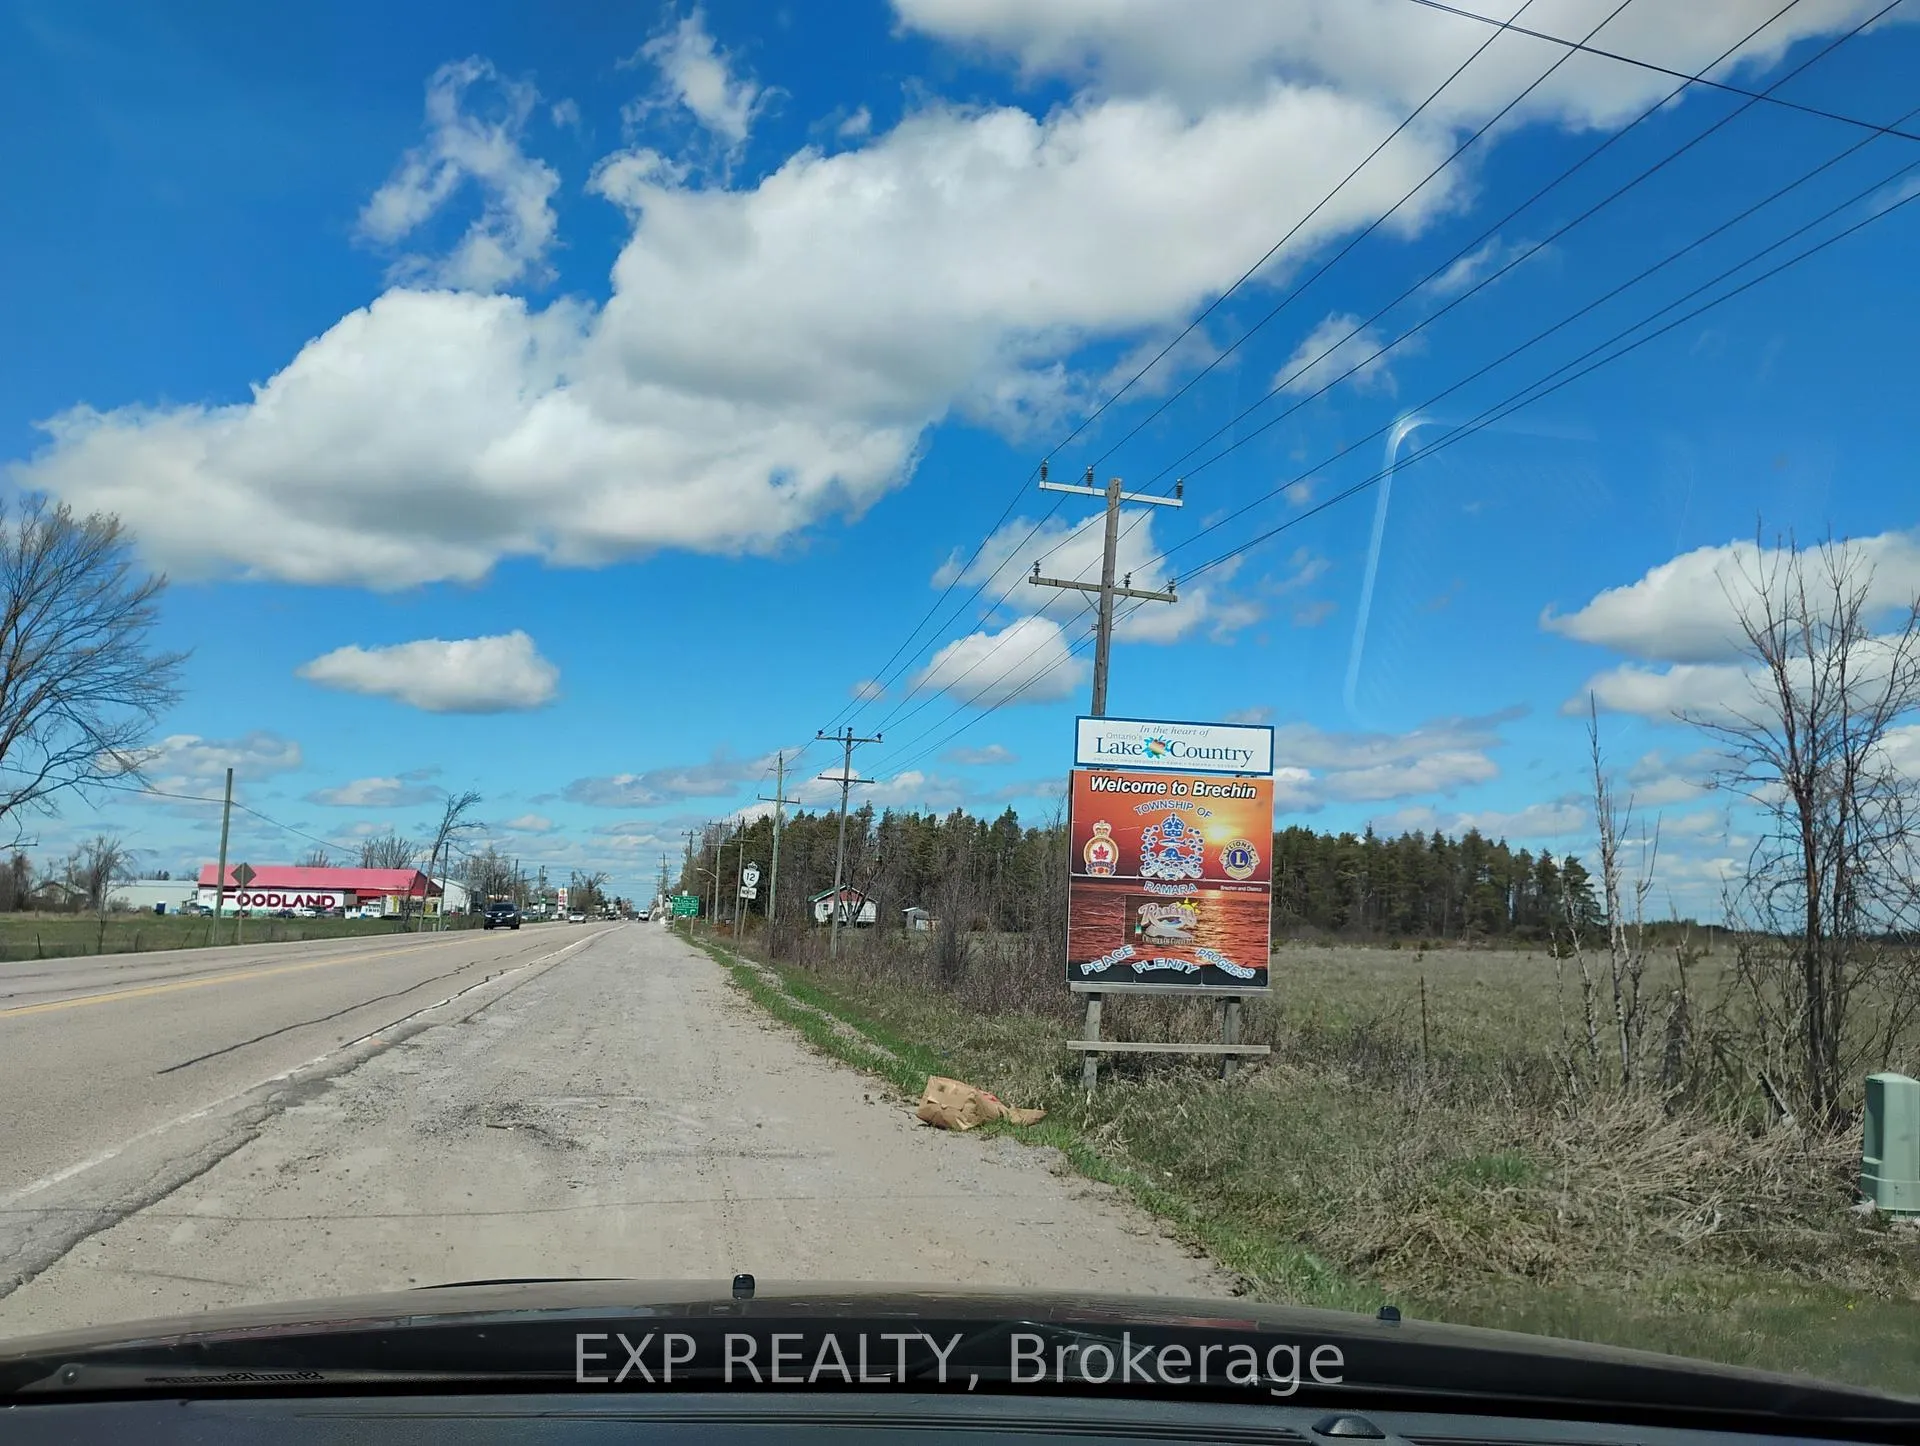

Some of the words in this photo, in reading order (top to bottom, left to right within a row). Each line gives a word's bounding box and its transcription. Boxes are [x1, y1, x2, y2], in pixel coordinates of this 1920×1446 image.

[1140, 725, 1149, 733] In
[1152, 726, 1168, 735] the
[1171, 726, 1197, 736] heart
[1200, 728, 1210, 737] of
[1096, 737, 1142, 756] Lake
[1170, 740, 1254, 768] Country
[1089, 776, 1168, 795] Welcome
[1171, 781, 1188, 796] to
[1192, 781, 1257, 799] Brechin
[1134, 800, 1194, 816] TOWNSHIP
[1196, 807, 1213, 818] OF
[1229, 841, 1252, 850] LIONS
[1235, 851, 1246, 866] L
[746, 872, 756, 881] 12
[1144, 881, 1198, 895] RAMARA
[220, 889, 336, 909] FOODLAND
[1081, 945, 1135, 975] PEACE
[1132, 958, 1200, 974] PLENTY
[1196, 948, 1256, 979] PROGRESS
